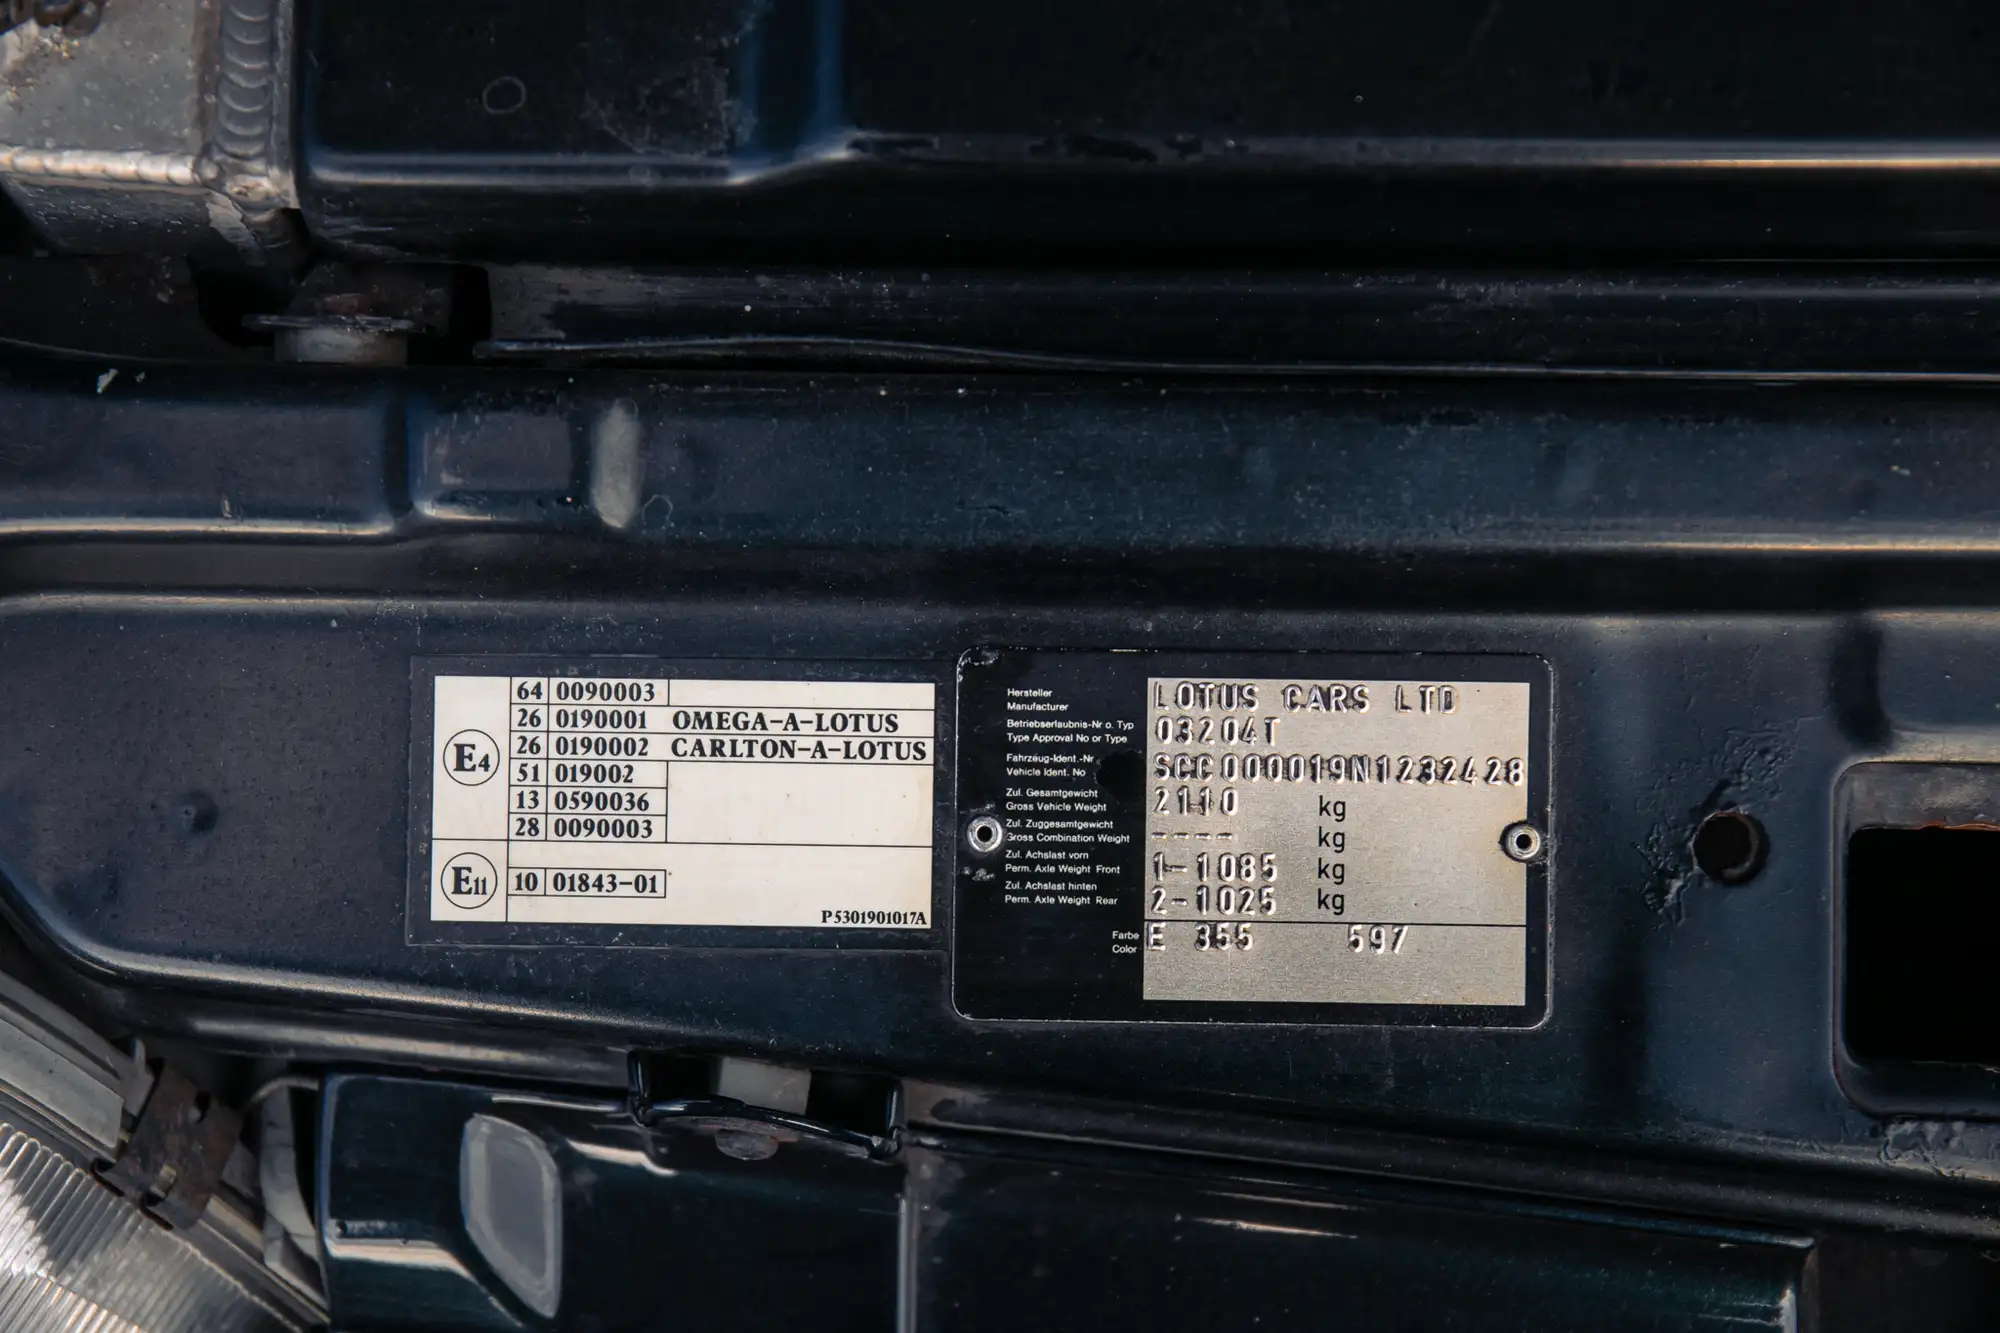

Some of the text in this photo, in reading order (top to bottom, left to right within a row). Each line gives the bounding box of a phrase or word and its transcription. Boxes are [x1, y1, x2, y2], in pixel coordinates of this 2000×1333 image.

[517, 681, 655, 702] 64 0090003
[1007, 688, 1052, 697] Hersteller
[1154, 681, 1457, 715] LOTUS CARS LTD
[1007, 702, 1068, 711] Manufacturer
[517, 708, 899, 733] 26 0190001 OMEGA-A-LOTUS
[1007, 719, 1102, 728] Betriebserlaubnis-Nr
[1117, 721, 1134, 730] Typ
[1156, 716, 1281, 746] 03204T
[1007, 733, 1029, 742] Type
[1033, 734, 1073, 742] Approval
[1076, 734, 1089, 742] No
[1105, 734, 1127, 744] Type
[517, 735, 927, 761] 26 0190002 CARLTON-A-LOTUS
[1007, 754, 1094, 763] Fahrzeug-Ident.-Nr
[516, 763, 633, 783] 51 019002
[1007, 767, 1040, 776] Vehicle
[1044, 768, 1069, 776] Ident.
[1153, 753, 1524, 787] SCC000019N1232428
[1006, 788, 1098, 798] Zul. Gesamtgewicht
[516, 790, 649, 811] 13 0590036
[1154, 786, 1346, 822] 2110 kg
[1006, 802, 1106, 813] Gross Vehicle Weight
[515, 817, 653, 838] 28 0090003
[1006, 819, 1113, 829] Zul. Zuggesamtgewicht
[1007, 833, 1130, 844] Gross Combination Weight
[1318, 826, 1345, 853] kg
[1005, 850, 1022, 858] Zul.
[1026, 850, 1065, 859] Achslast
[1005, 864, 1120, 874] Perm. Axle Weight Front
[1318, 858, 1345, 885] kg
[515, 872, 657, 893] 10 01843-01
[1005, 881, 1097, 891] Zul. Achslast hinten
[1005, 895, 1118, 906] Perm. Axle Weight Rear
[1318, 888, 1344, 915] kg
[1112, 931, 1139, 940] Farbe
[1147, 922, 1408, 954] E 355 597
[1112, 945, 1137, 953] Color
